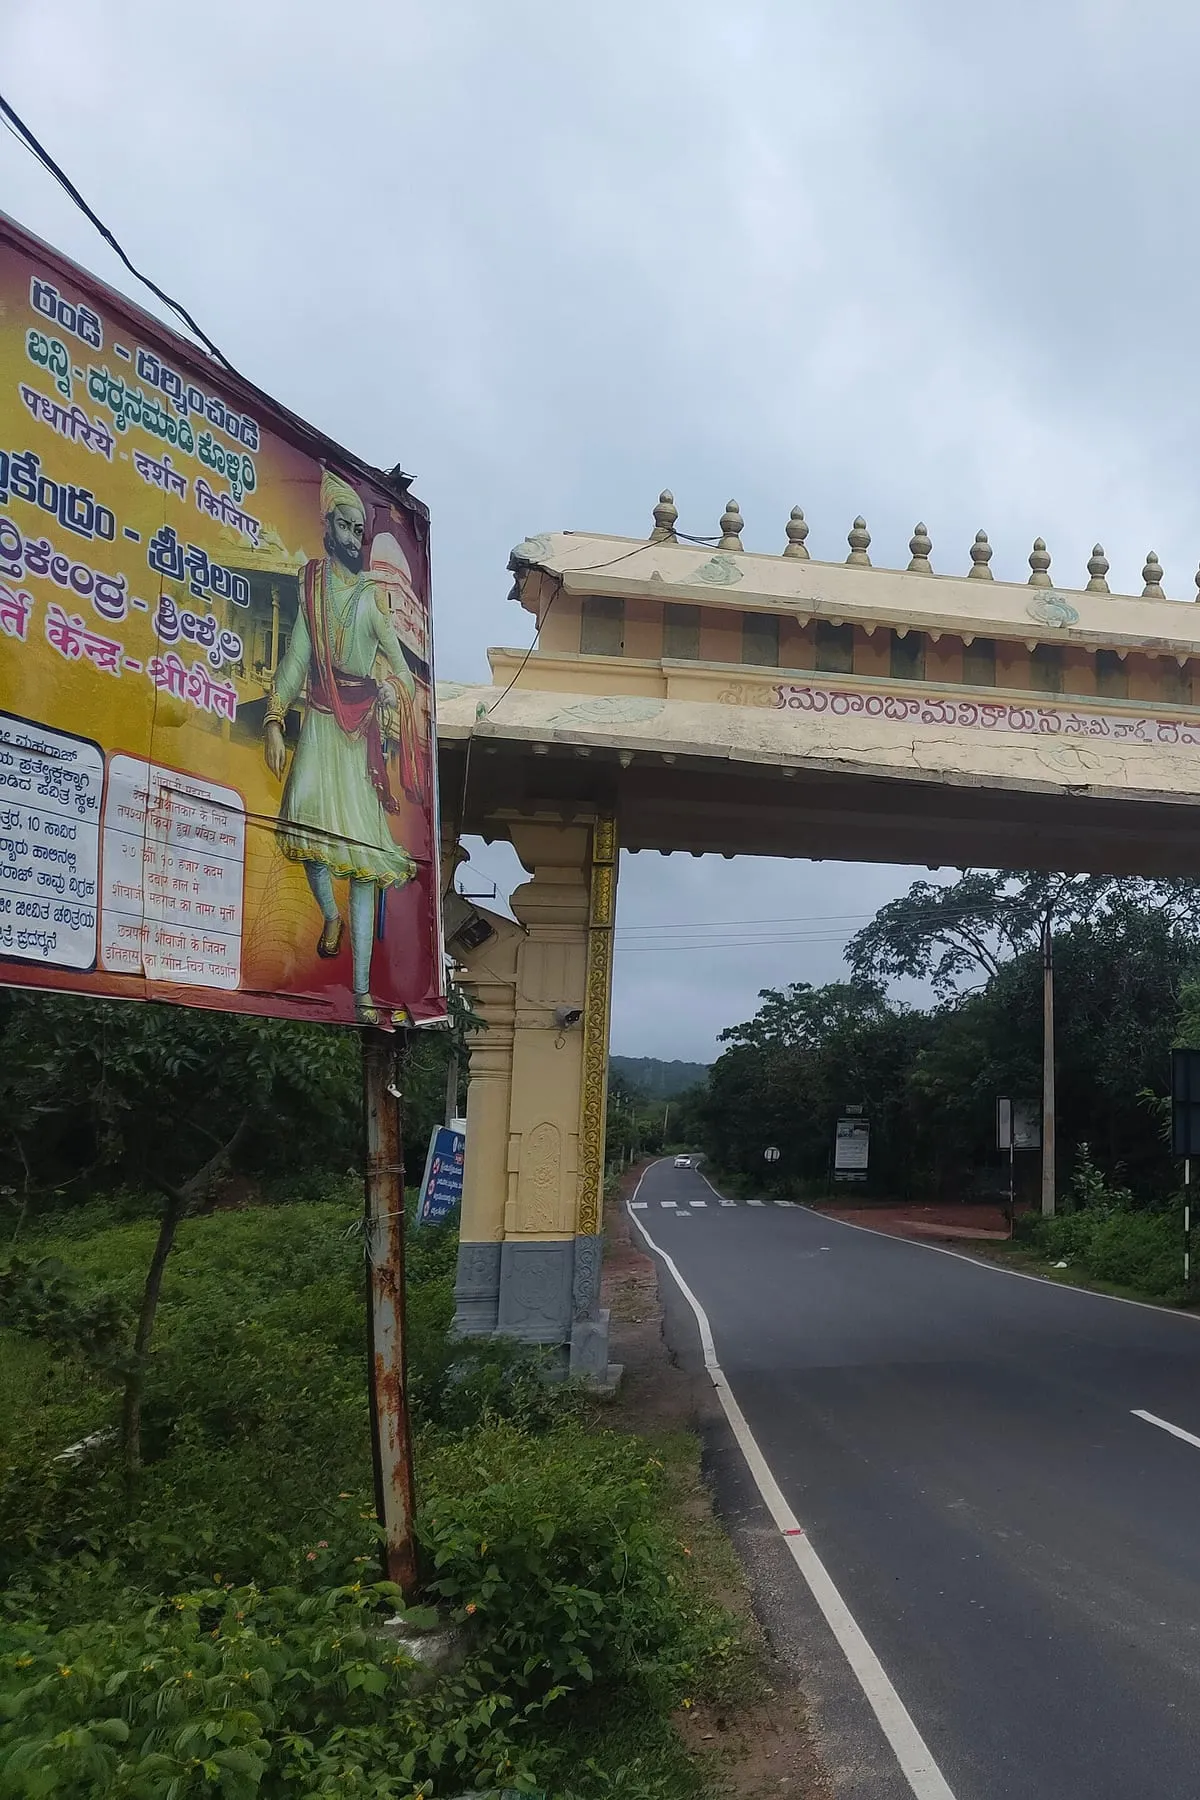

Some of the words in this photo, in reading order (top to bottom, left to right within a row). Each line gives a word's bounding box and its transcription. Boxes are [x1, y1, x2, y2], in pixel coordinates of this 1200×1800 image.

[31, 277, 102, 350] రండి
[27, 330, 71, 399] ಬನ್ನಿ
[21, 384, 114, 460] पधारिये
[133, 455, 188, 501] दर्शन
[195, 478, 260, 546] किजिए
[148, 525, 250, 607] శ్రీశైలం
[155, 596, 242, 666] ಶ್ರೀಶೈಲ
[28, 816, 40, 832] 10
[37, 782, 70, 805] ಪವಿತ್ರ
